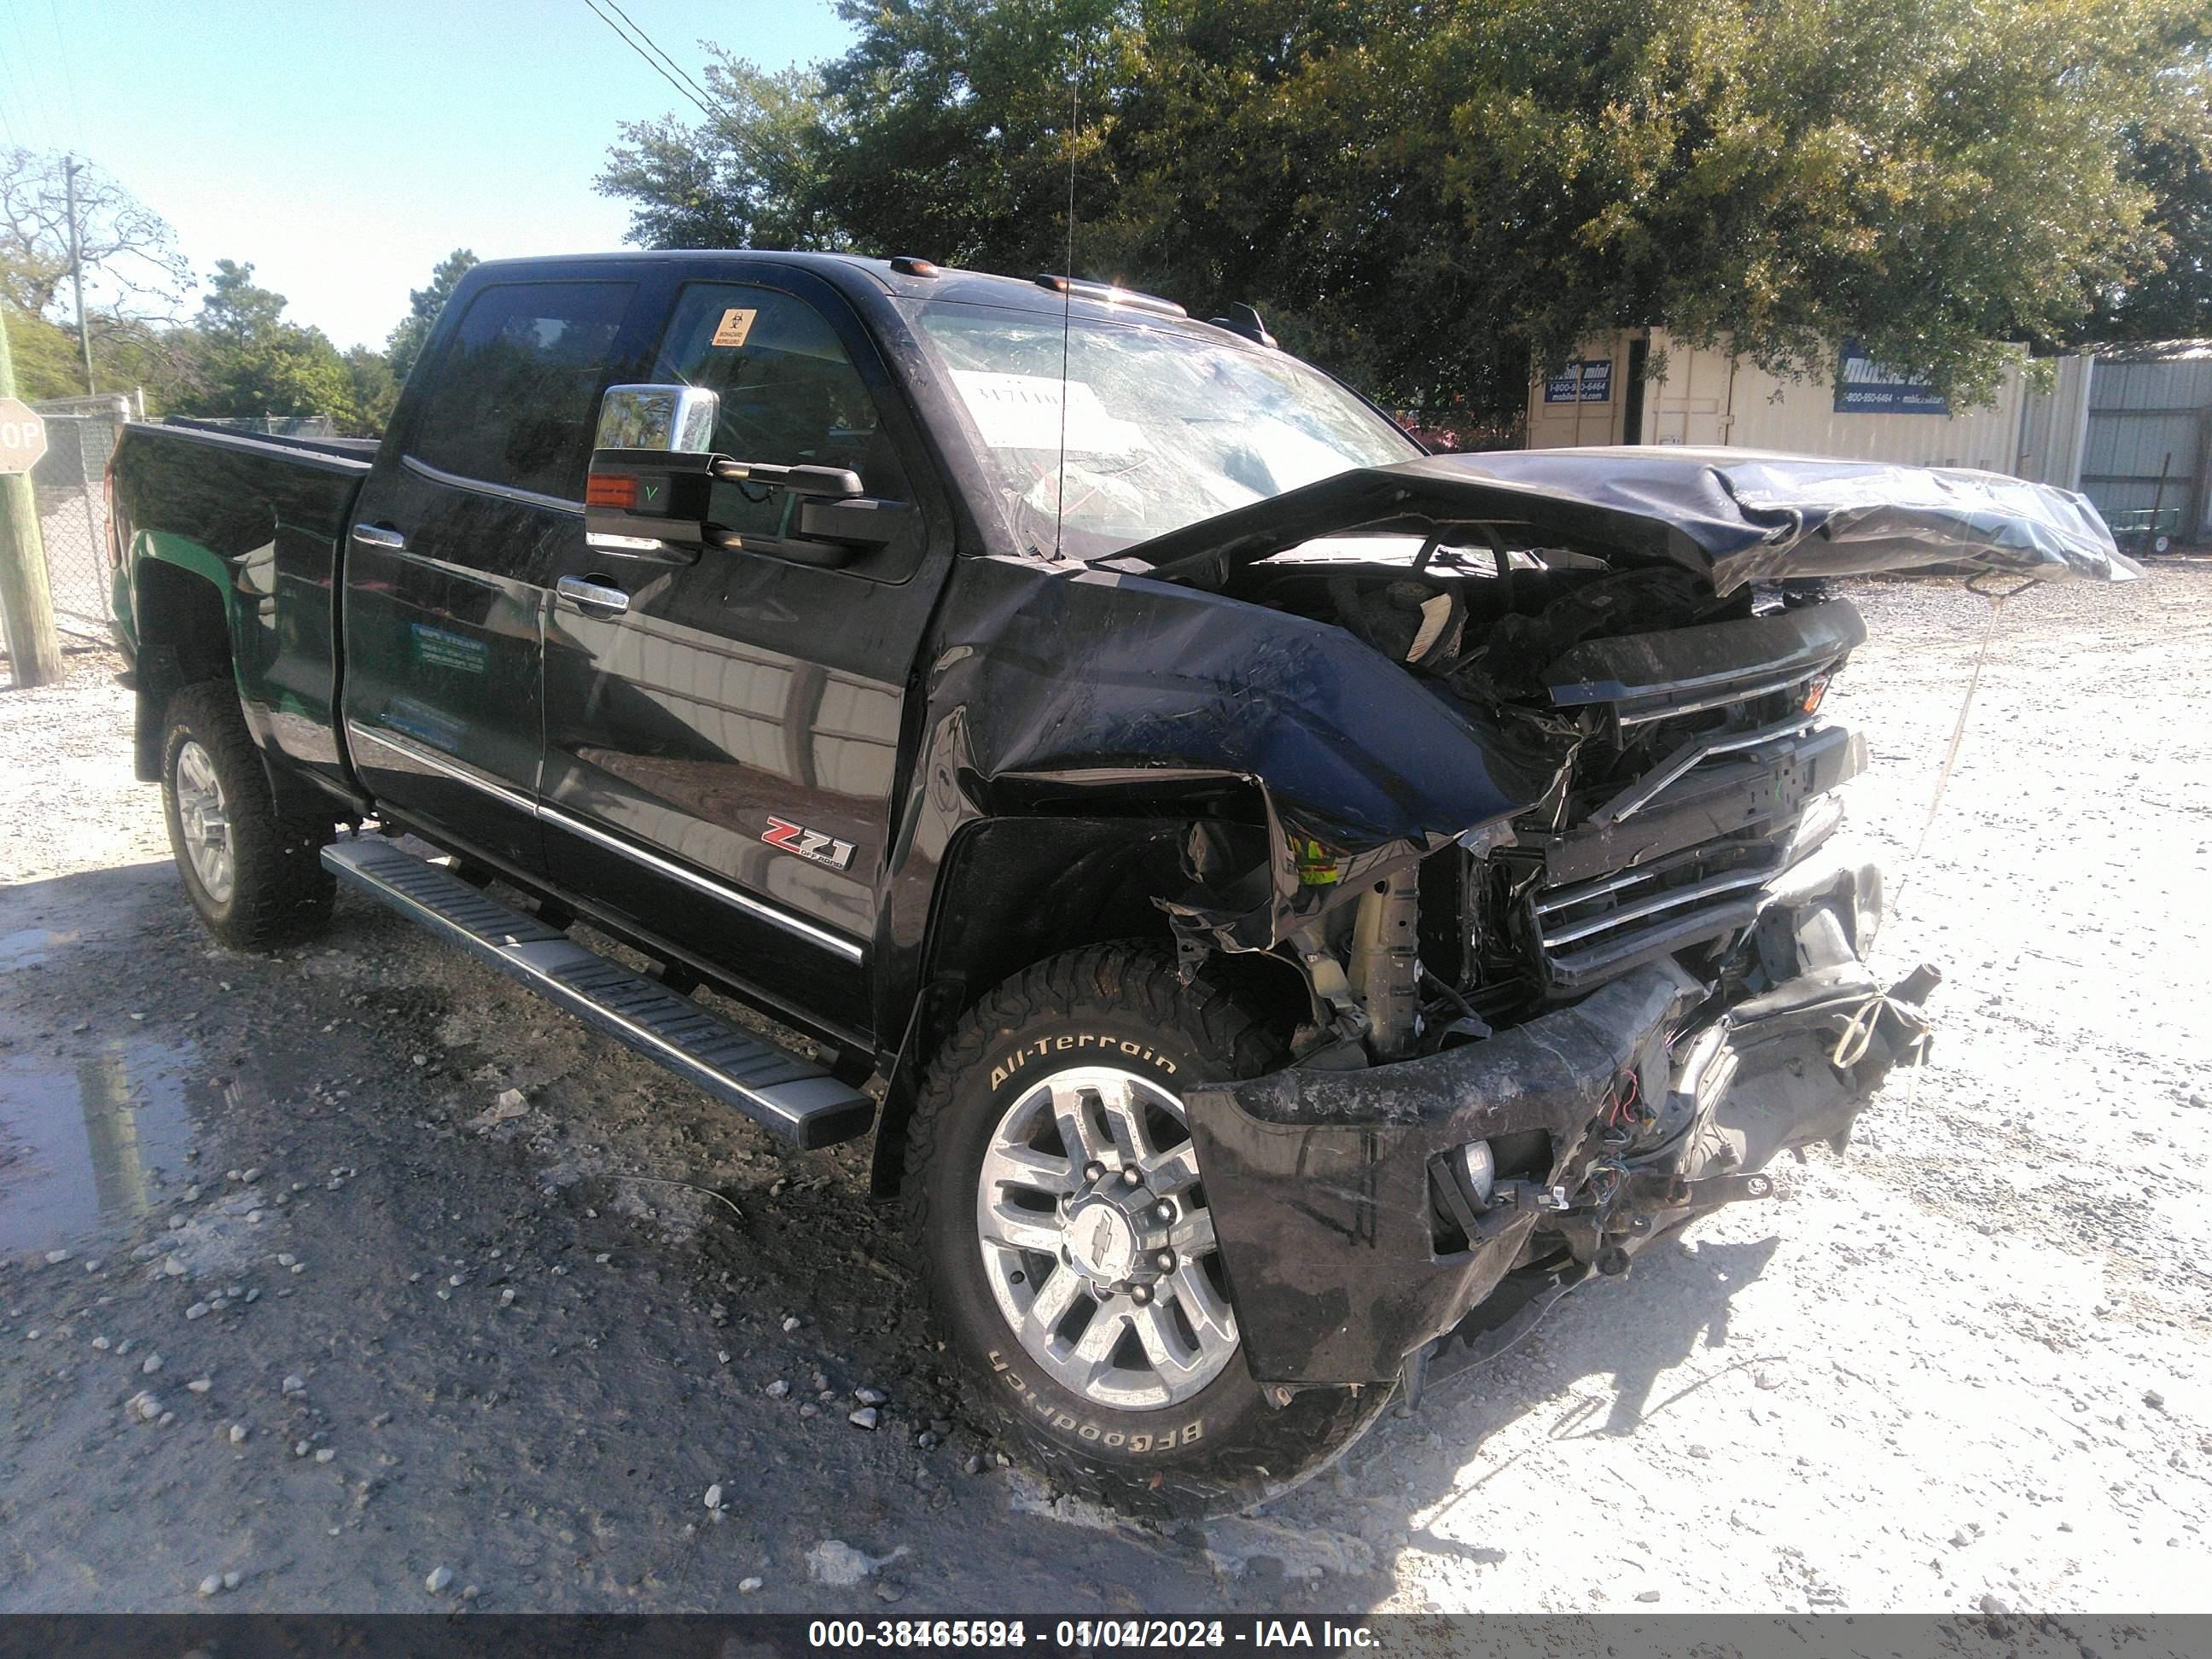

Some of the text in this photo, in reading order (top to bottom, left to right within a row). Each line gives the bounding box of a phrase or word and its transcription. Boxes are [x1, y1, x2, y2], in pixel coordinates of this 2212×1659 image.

[1584, 364, 1611, 379] mini
[1550, 382, 1605, 392] 1-800-90-6464
[1844, 393, 1893, 403] -800-950-6464
[1, 422, 39, 451] OP
[761, 815, 857, 870] Z71
[800, 849, 844, 869] OFF ROAD
[991, 1034, 1177, 1092] All-Terrain
[988, 1350, 1203, 1453] BFGoodrich
